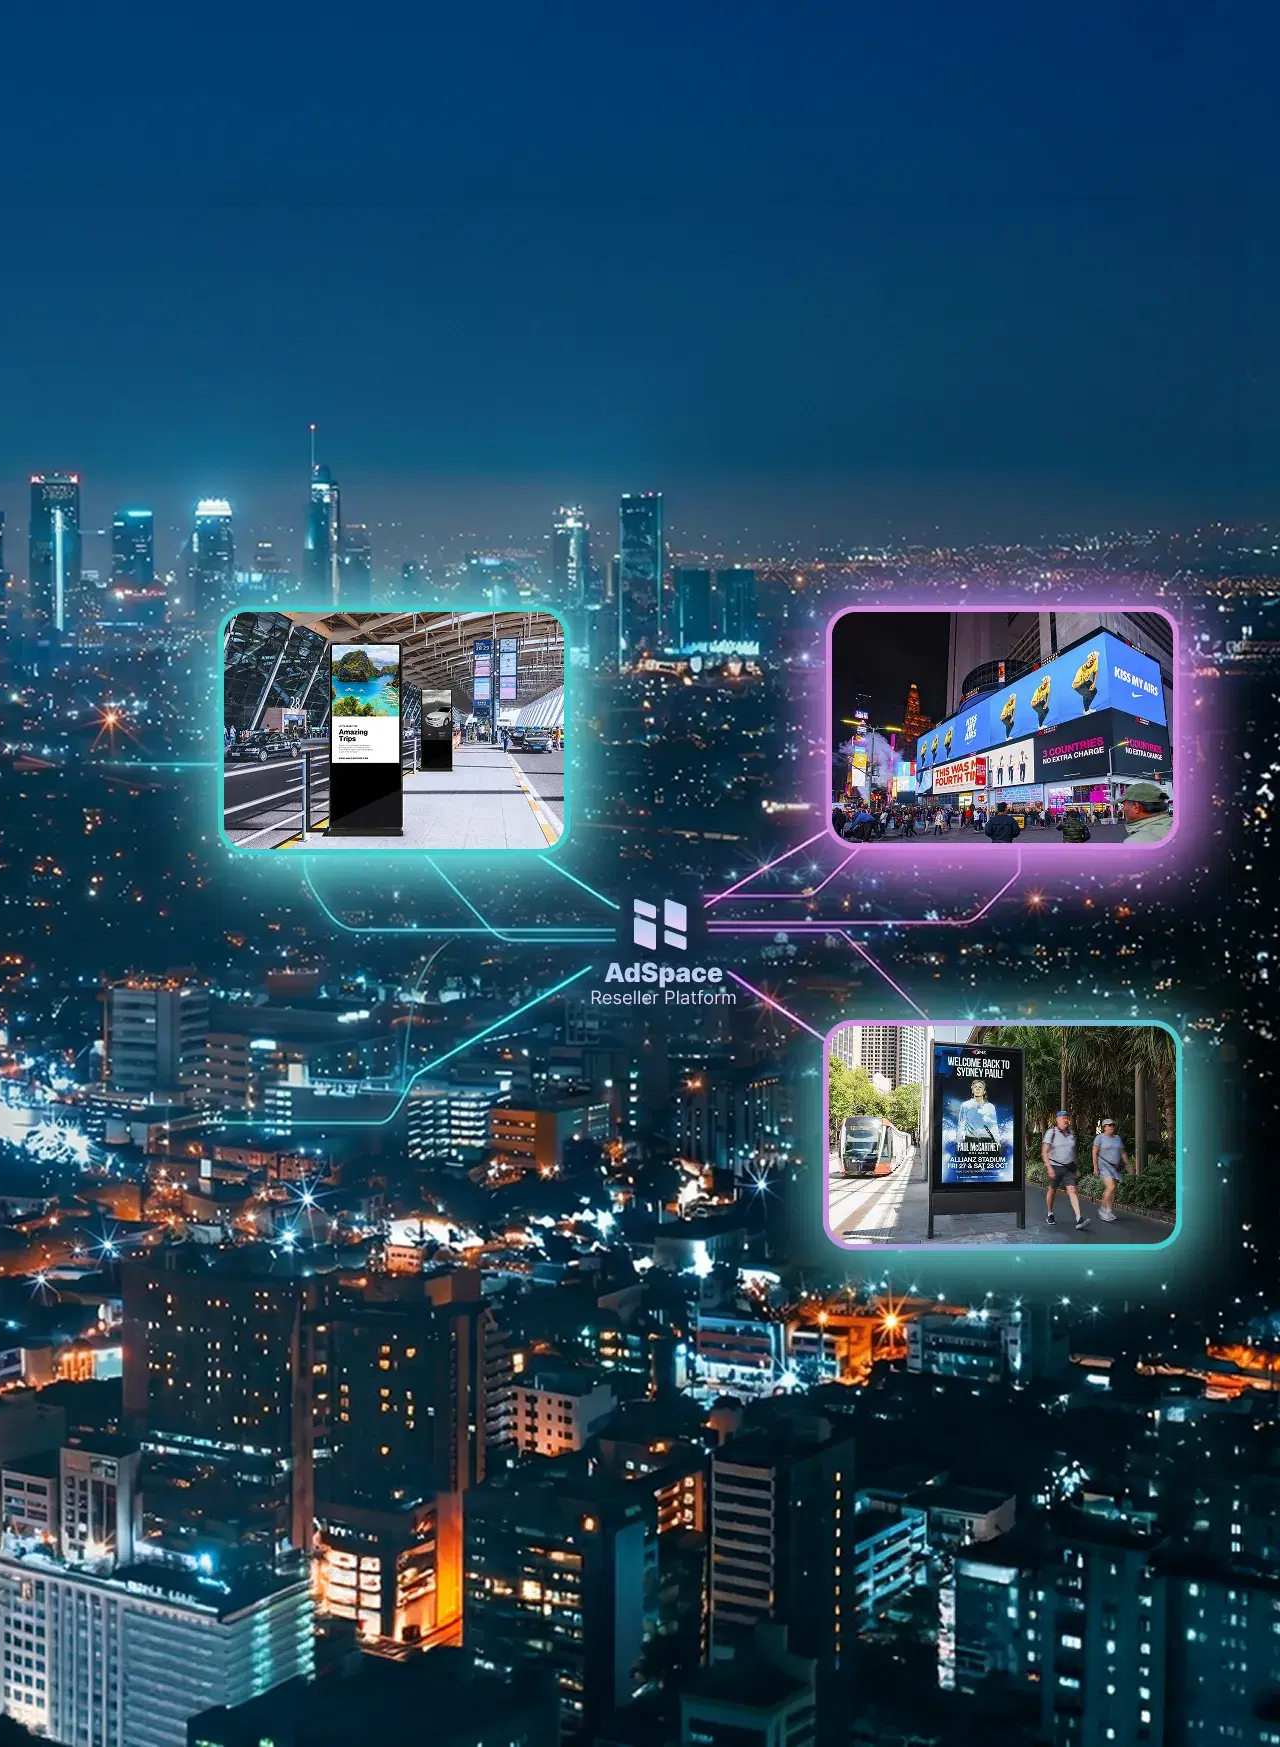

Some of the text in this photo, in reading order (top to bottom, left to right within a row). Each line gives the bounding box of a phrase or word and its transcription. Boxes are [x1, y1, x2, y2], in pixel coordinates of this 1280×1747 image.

[1114, 666, 1158, 696] KISS MY AIRS
[290, 696, 300, 710] 28
[338, 728, 368, 736] Amazing
[1042, 736, 1104, 758] 3 COUNTRIES
[1130, 738, 1162, 753] COUNTRIES
[1132, 748, 1148, 757] EXTRA
[1042, 746, 1104, 764] NO EXTRA CHARGE
[936, 766, 950, 778] THIS
[951, 762, 969, 773] WAS
[936, 774, 962, 786] FOURTH
[948, 1056, 1010, 1070] WELCOME BACK TO
[956, 1067, 1004, 1078] SYDNEY PAUL!
[958, 1142, 970, 1152] PAUL
